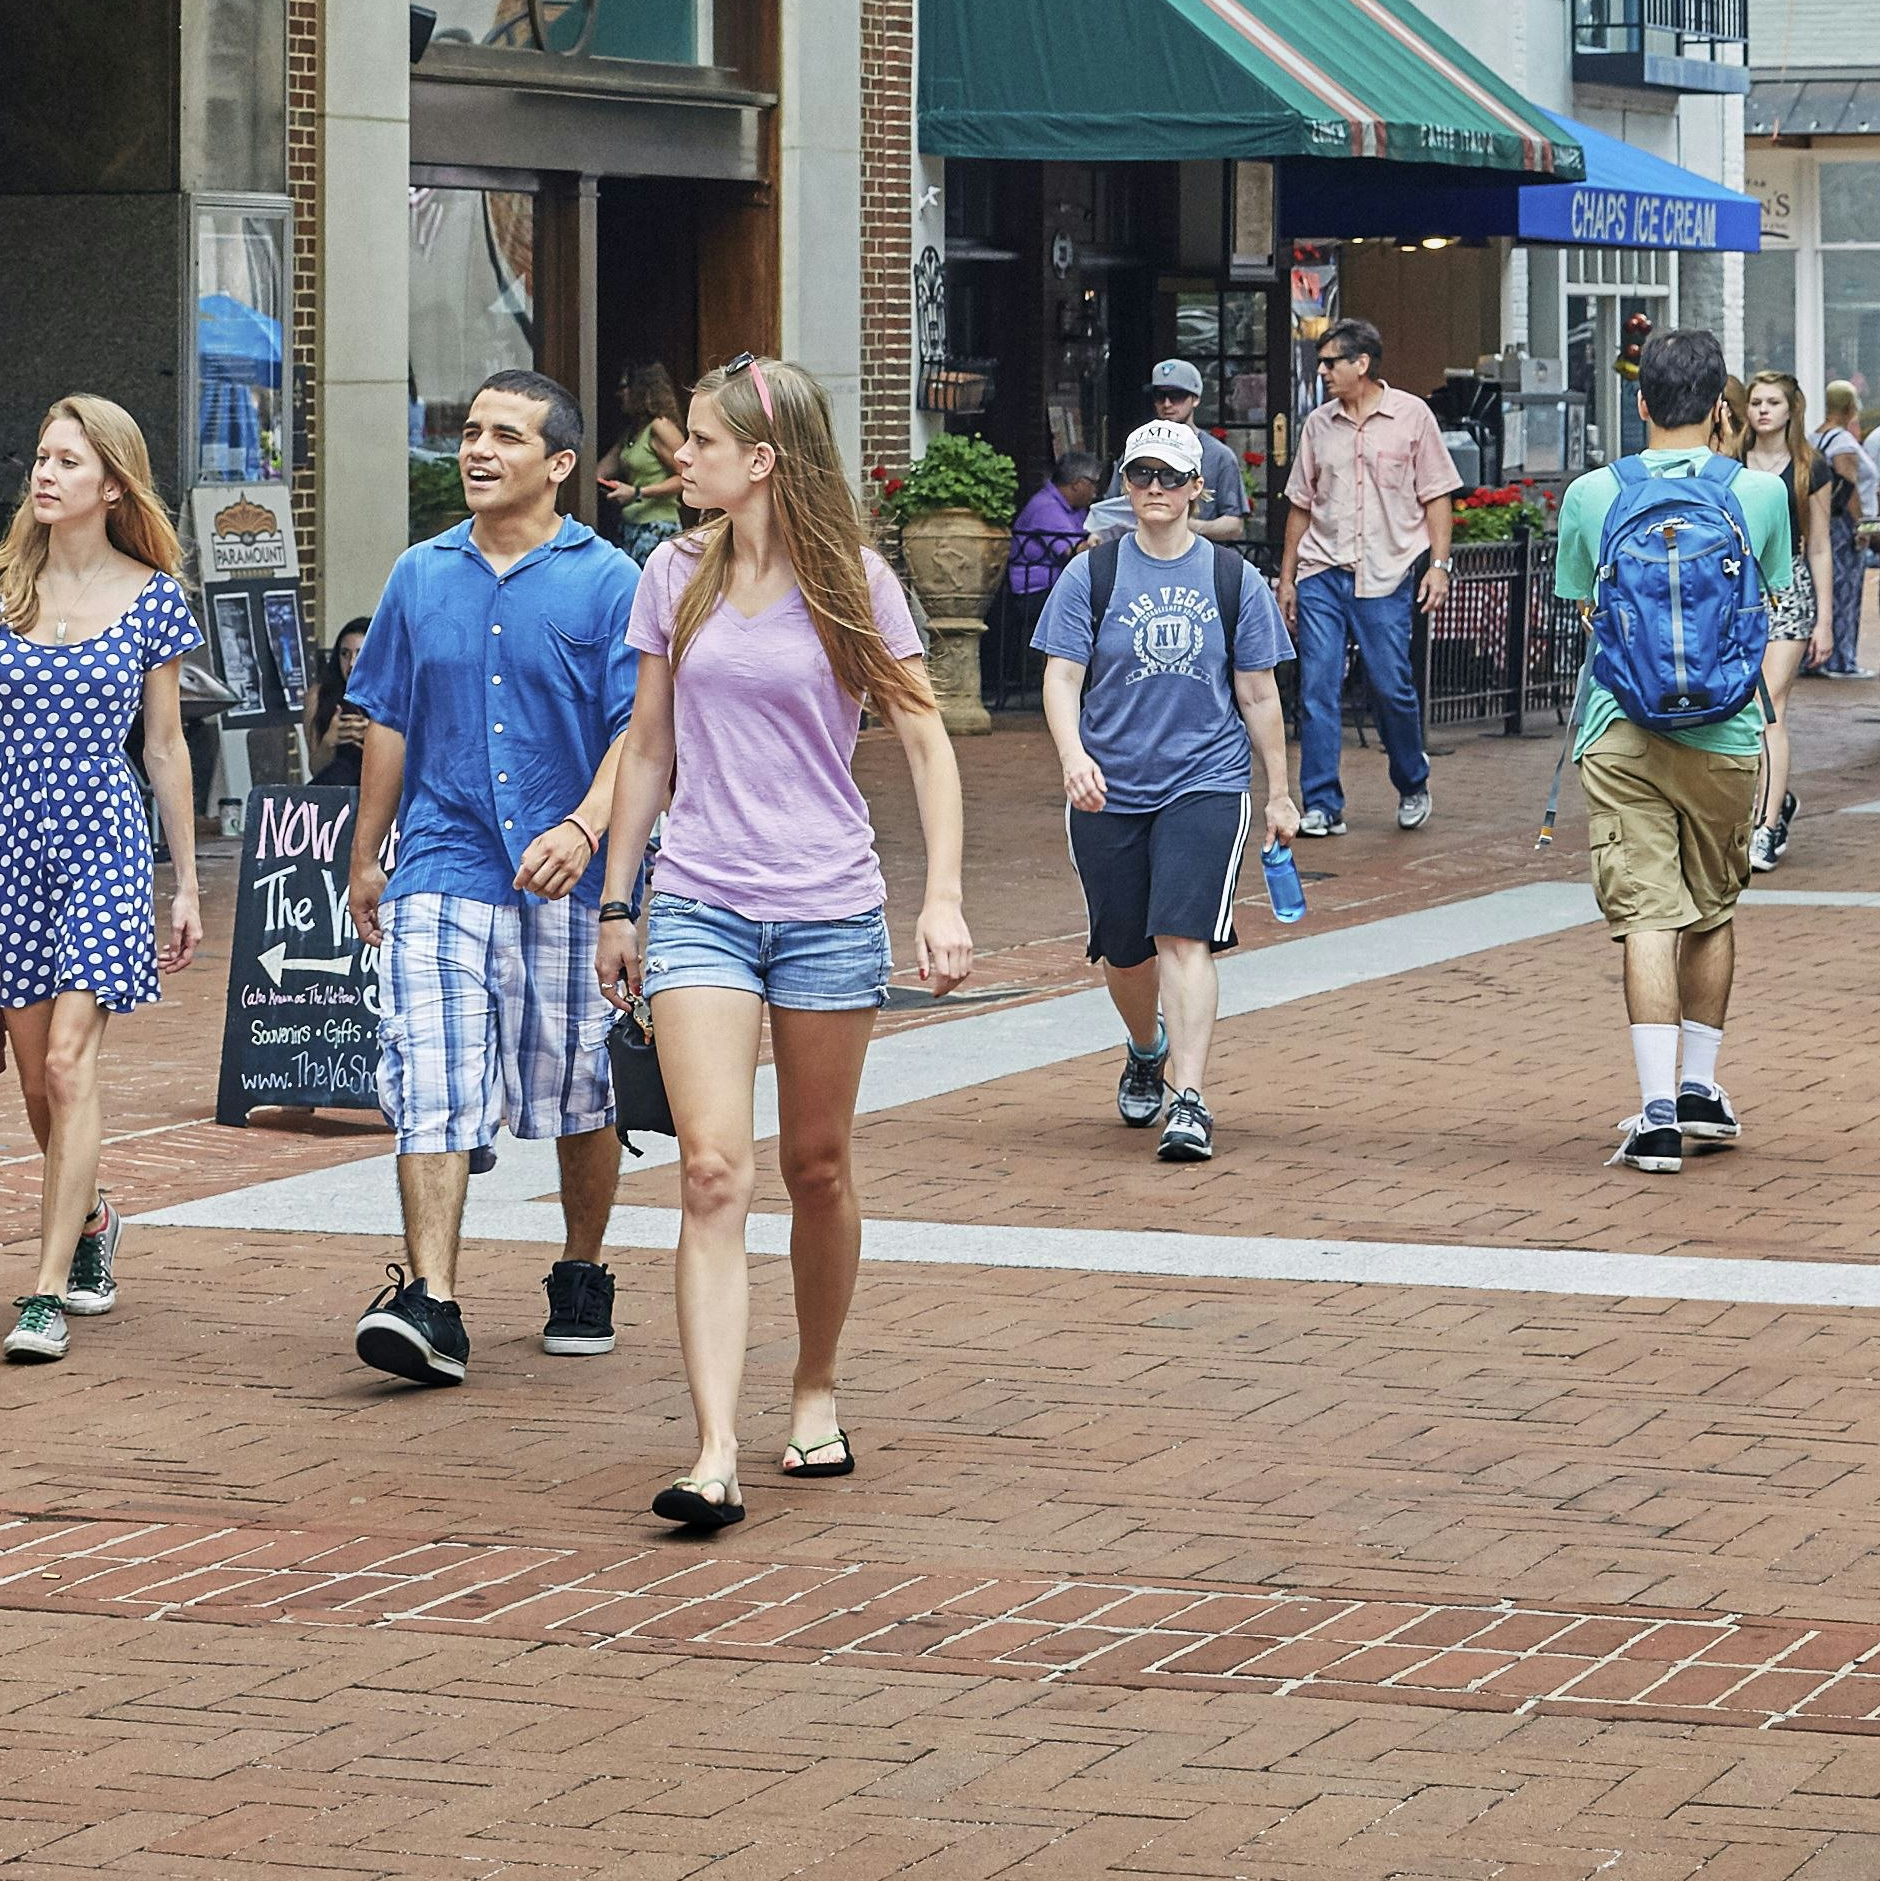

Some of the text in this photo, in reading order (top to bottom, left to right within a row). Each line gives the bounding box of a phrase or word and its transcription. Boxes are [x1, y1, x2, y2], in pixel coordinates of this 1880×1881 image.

[1571, 189, 1718, 249] CHAPS ICE CREAM
[216, 547, 283, 565] PARAMOUNT
[1118, 586, 1219, 628] LAS VEGAS
[1155, 623, 1181, 647] NV
[255, 797, 351, 863] NOW
[253, 865, 316, 933] The
[251, 1017, 363, 1049] Souvenirs Gifts
